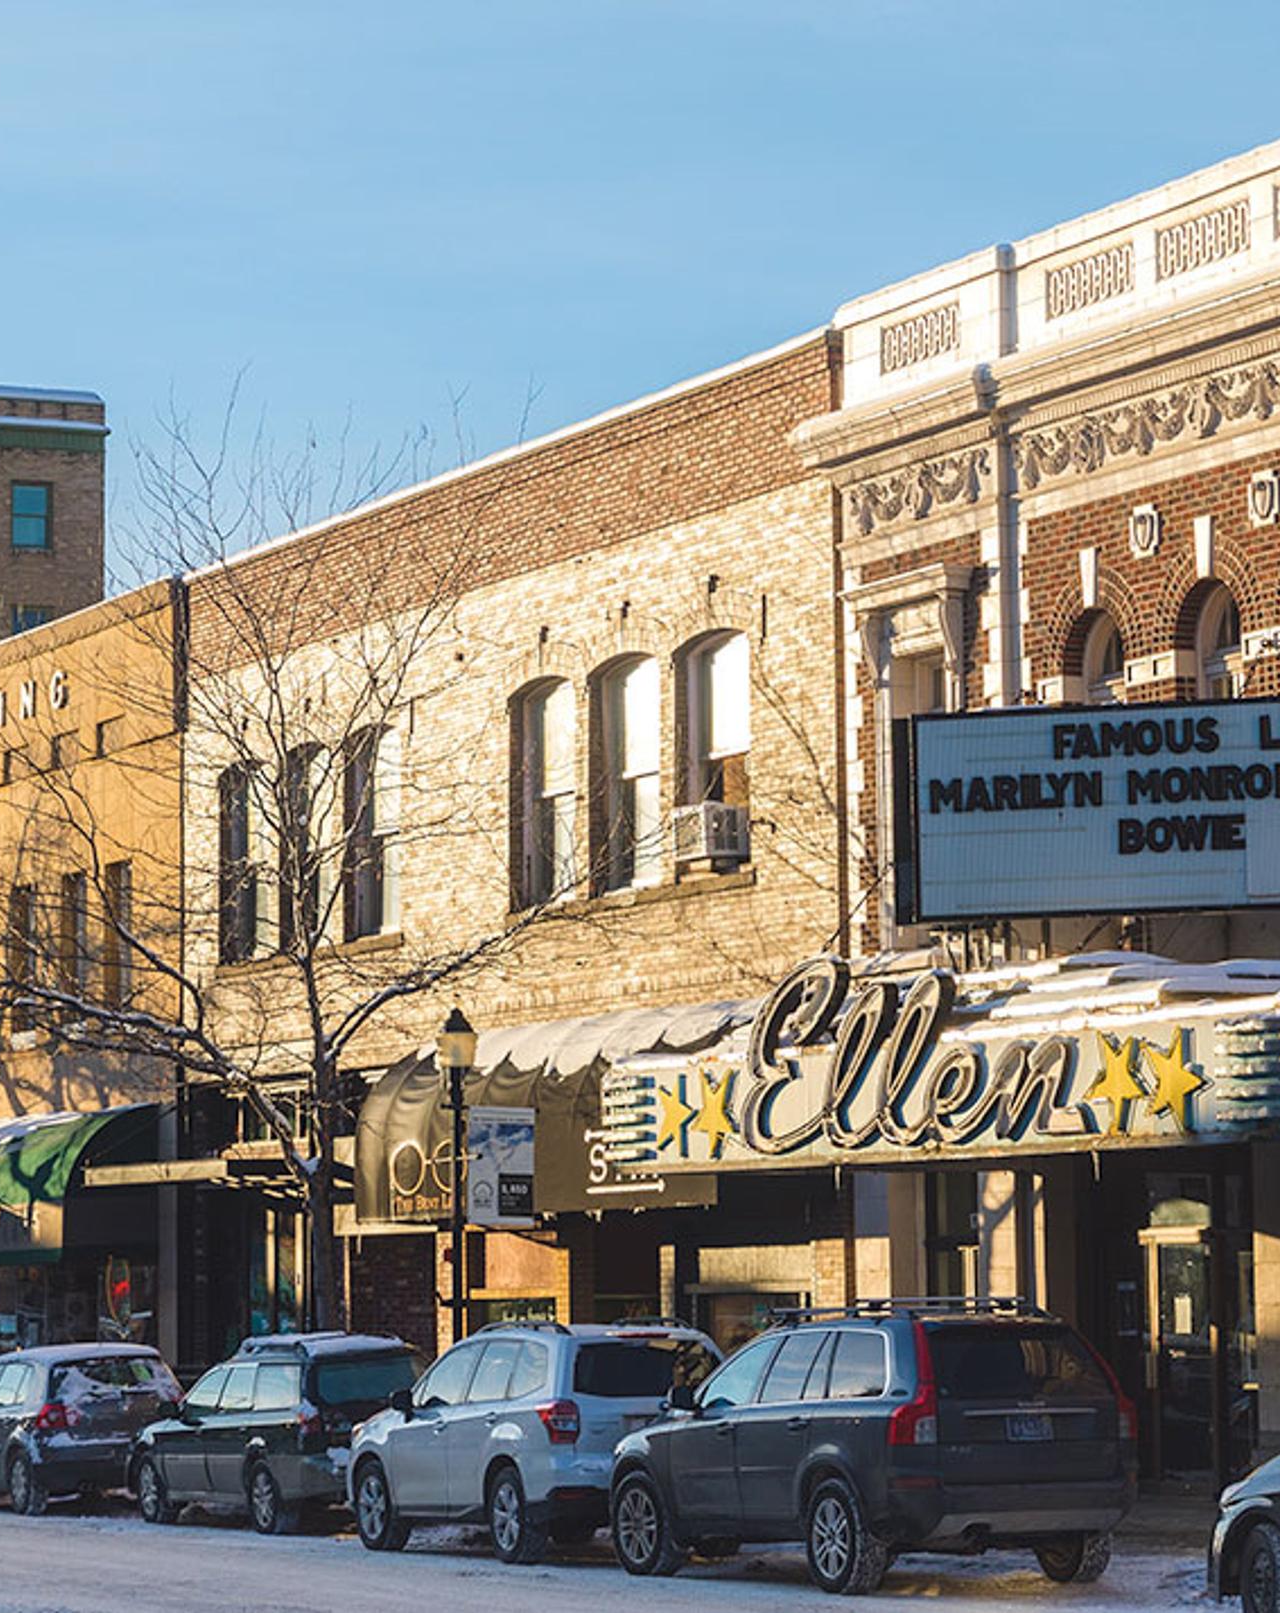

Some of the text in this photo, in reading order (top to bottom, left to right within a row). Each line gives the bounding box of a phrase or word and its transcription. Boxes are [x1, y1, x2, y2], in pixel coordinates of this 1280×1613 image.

[1052, 717, 1220, 760] FAMOUS
[929, 770, 1103, 814] MARILYN
[1117, 813, 1247, 855] BOWIE
[739, 954, 1105, 1156] Ellen
